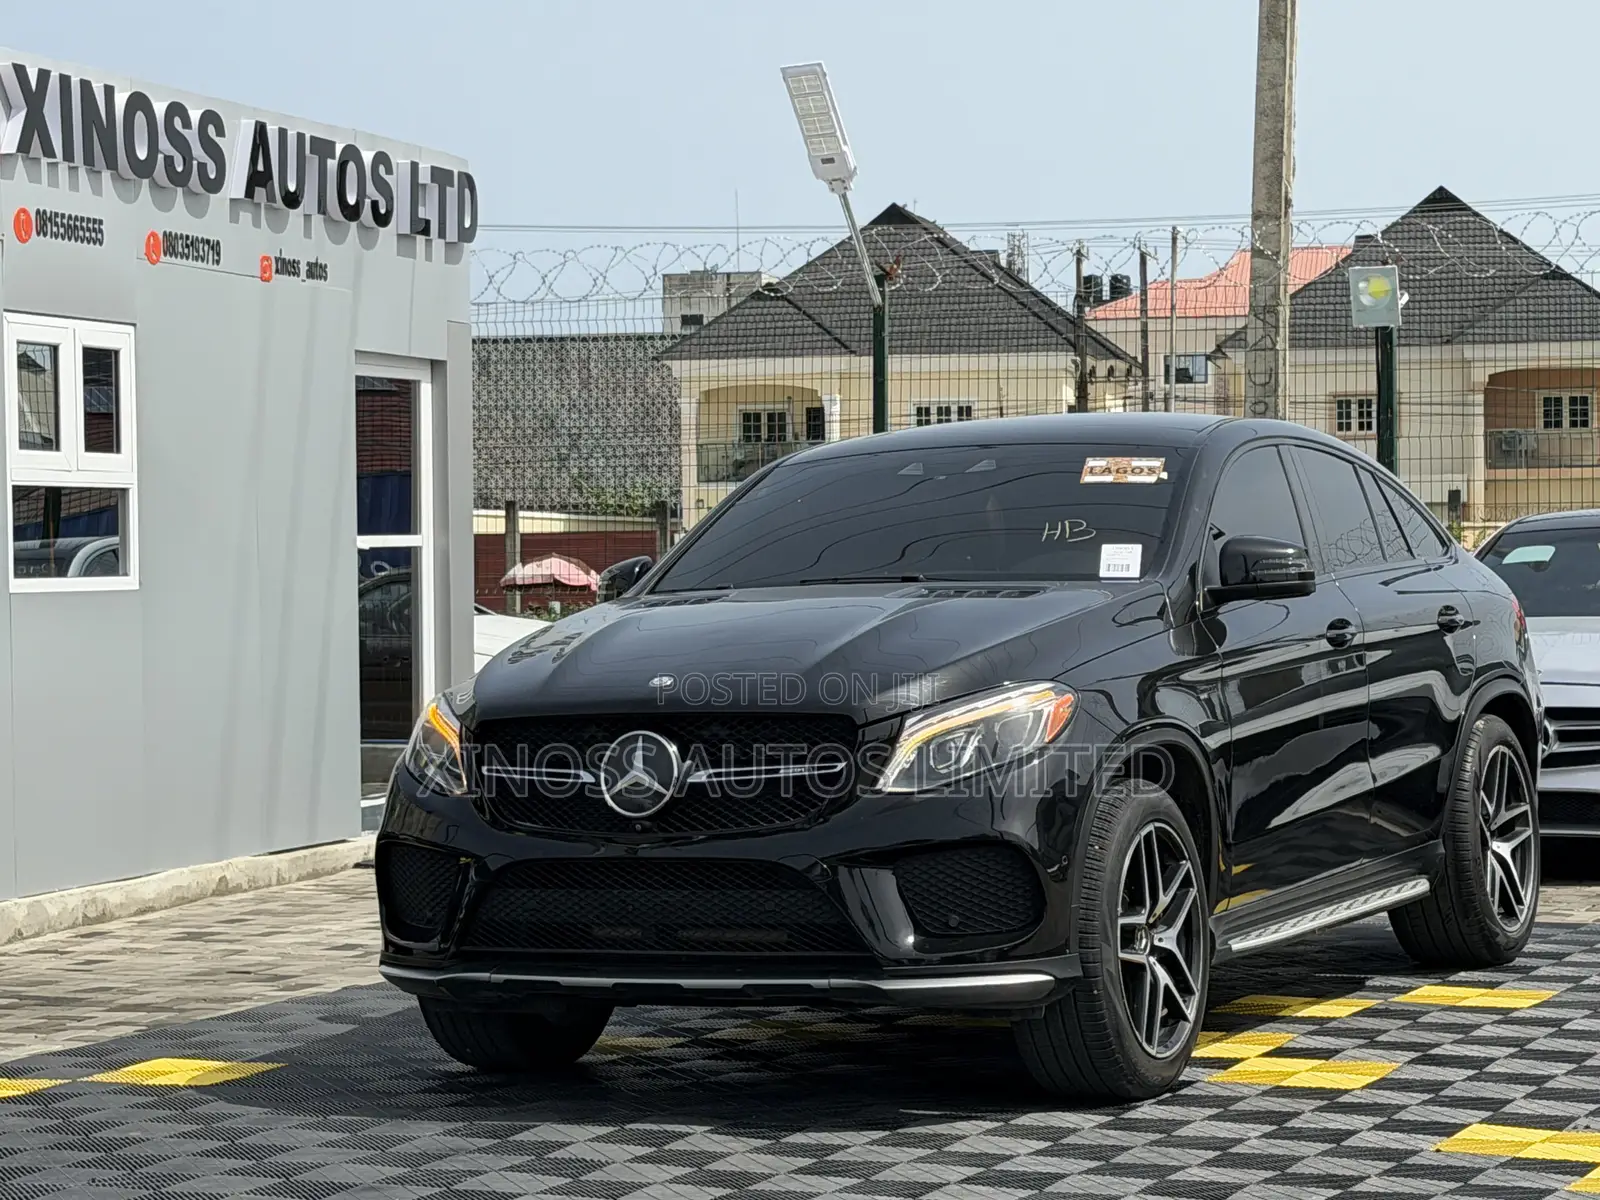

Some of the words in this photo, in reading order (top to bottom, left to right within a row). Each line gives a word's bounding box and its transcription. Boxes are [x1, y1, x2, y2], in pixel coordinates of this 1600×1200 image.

[12, 62, 227, 195] XINOSS
[244, 119, 394, 229] AUTOS
[409, 159, 479, 244] LTD
[35, 207, 105, 247] 08155665555
[162, 230, 222, 267] 08035193719
[1088, 466, 1158, 475] LAGOS
[1041, 519, 1097, 543] HB
